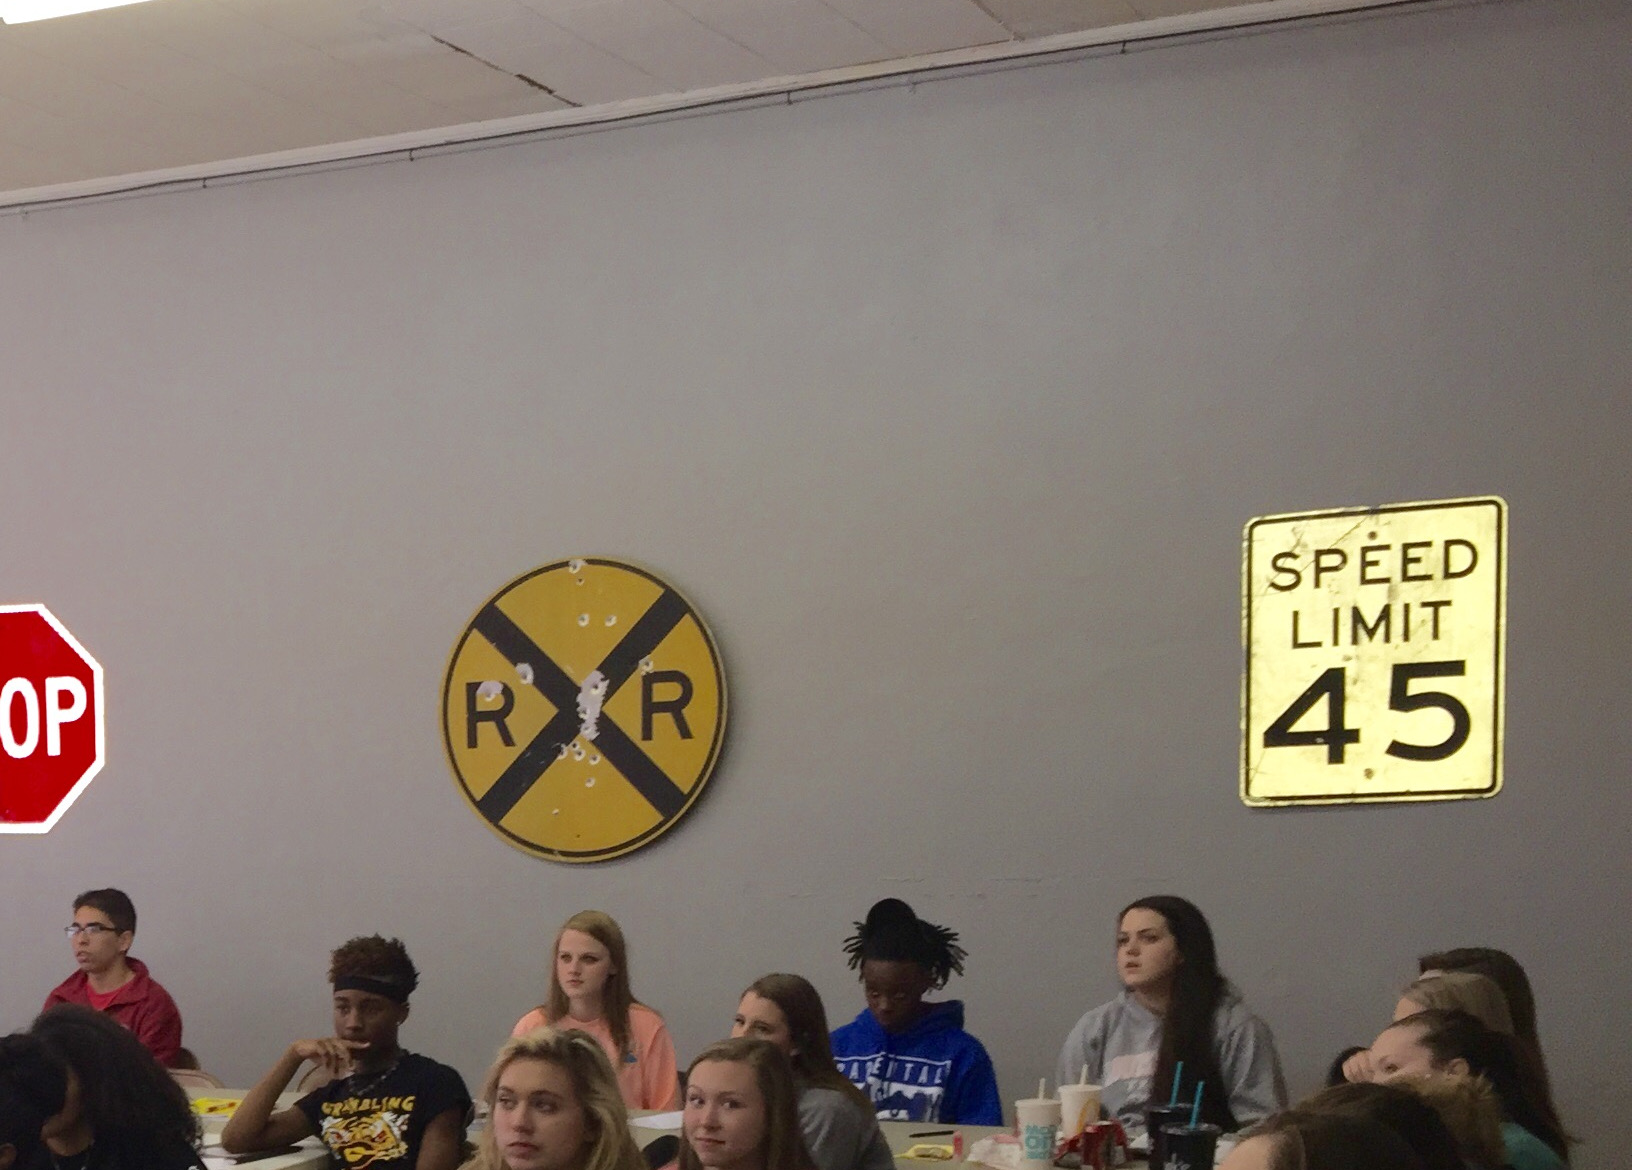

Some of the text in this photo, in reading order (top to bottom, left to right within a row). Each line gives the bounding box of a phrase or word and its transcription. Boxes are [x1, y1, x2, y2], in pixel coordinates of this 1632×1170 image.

[1269, 539, 1478, 591] SPEED
[1292, 600, 1452, 649] LIMIT
[466, 681, 515, 748] R
[641, 670, 694, 741] R
[1263, 660, 1471, 765] 45
